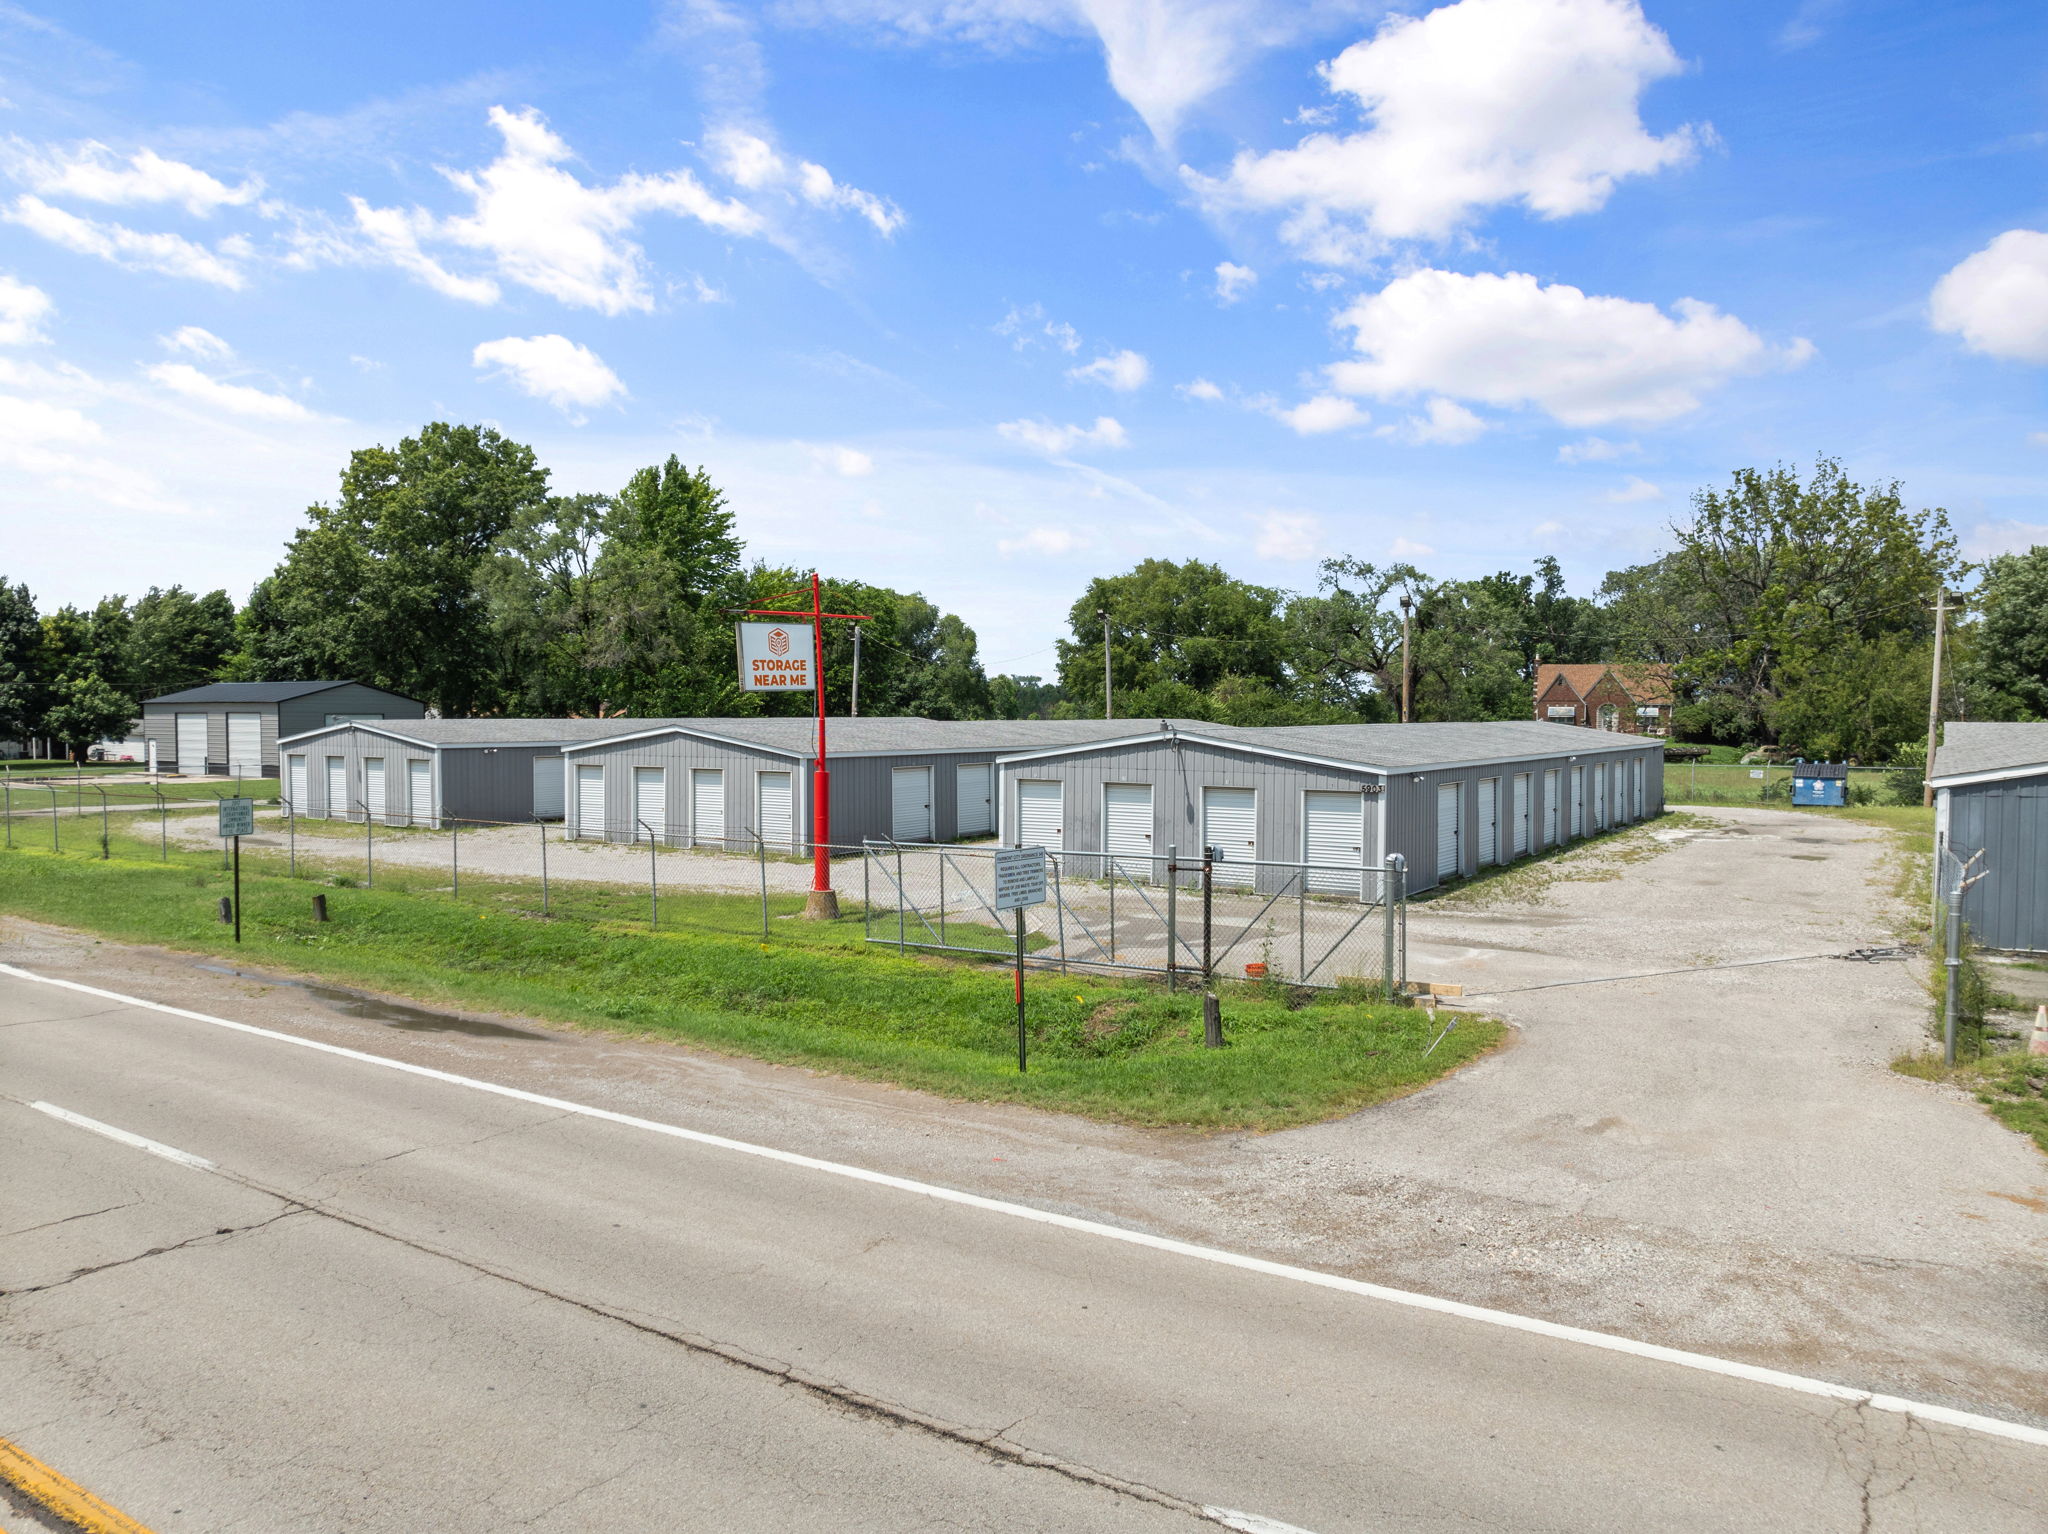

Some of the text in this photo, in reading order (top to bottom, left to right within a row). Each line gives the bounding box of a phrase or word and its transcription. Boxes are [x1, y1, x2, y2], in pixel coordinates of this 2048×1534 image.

[752, 660, 806, 671] STORAGE
[754, 674, 806, 686] NEAR ME
